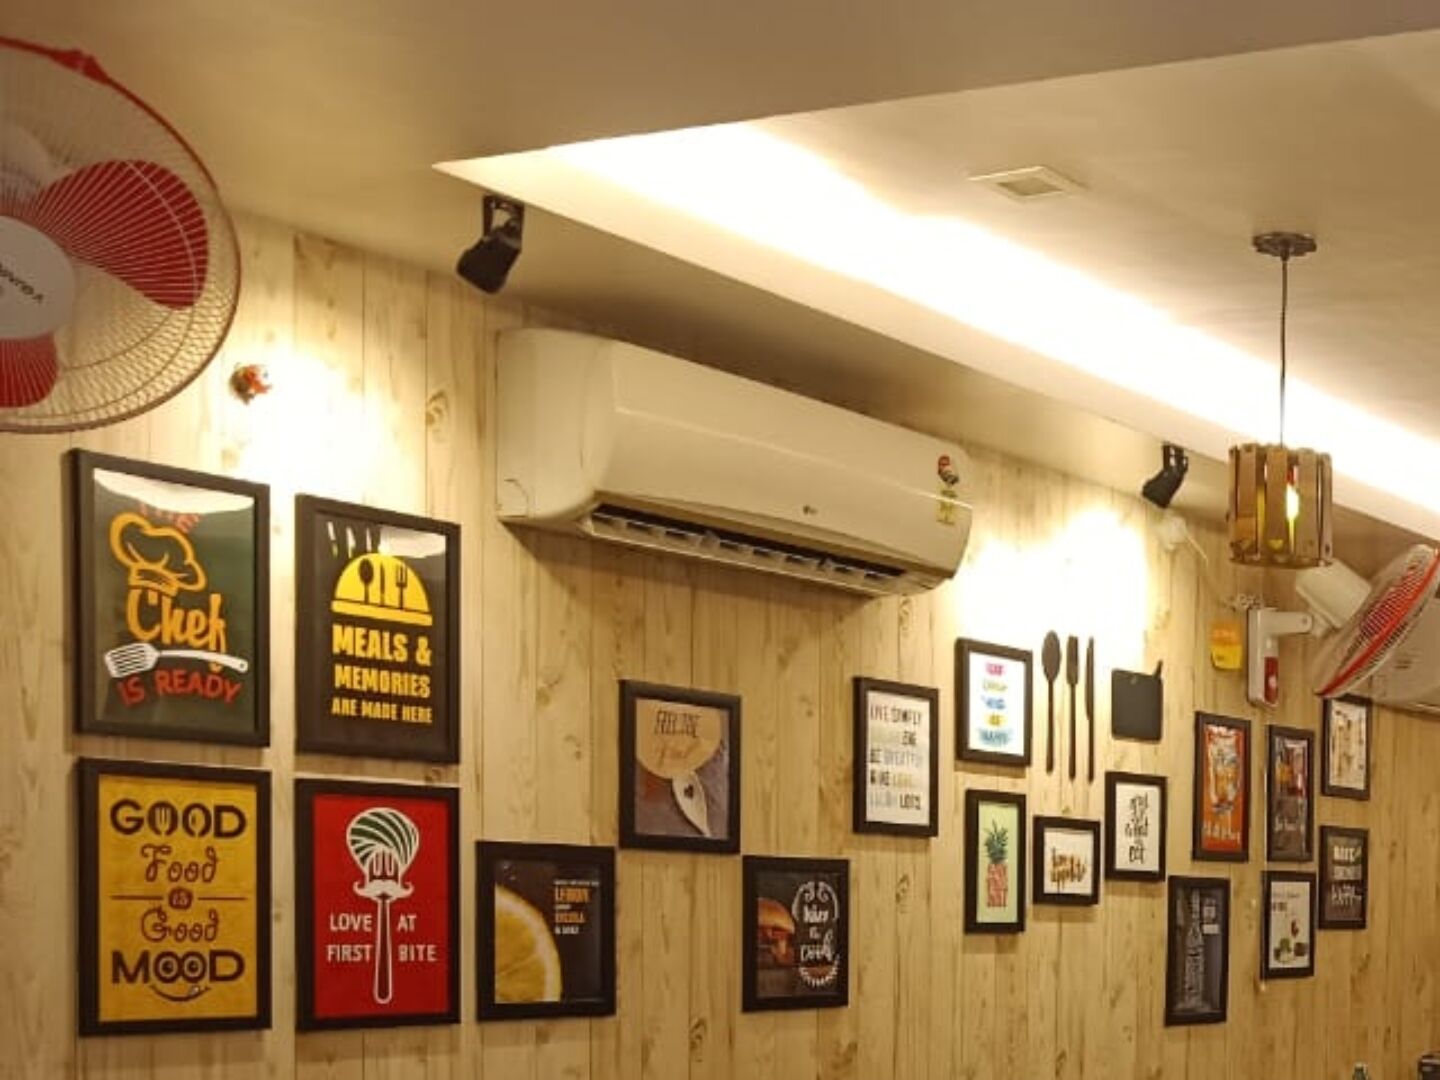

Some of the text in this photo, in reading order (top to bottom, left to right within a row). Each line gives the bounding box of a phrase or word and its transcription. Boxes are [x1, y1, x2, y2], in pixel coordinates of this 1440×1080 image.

[126, 588, 226, 674] Chef
[331, 623, 432, 666] MEALS &
[116, 667, 242, 705] IS READY
[334, 663, 431, 698] MEMORIES
[330, 696, 433, 723] ARE MADE HERE
[110, 799, 247, 839] GOOD
[140, 843, 220, 883] Food
[141, 905, 220, 943] Good
[330, 912, 417, 932] LOVE AT
[111, 951, 245, 984] MOOD
[327, 944, 438, 962] FIRST BITE
